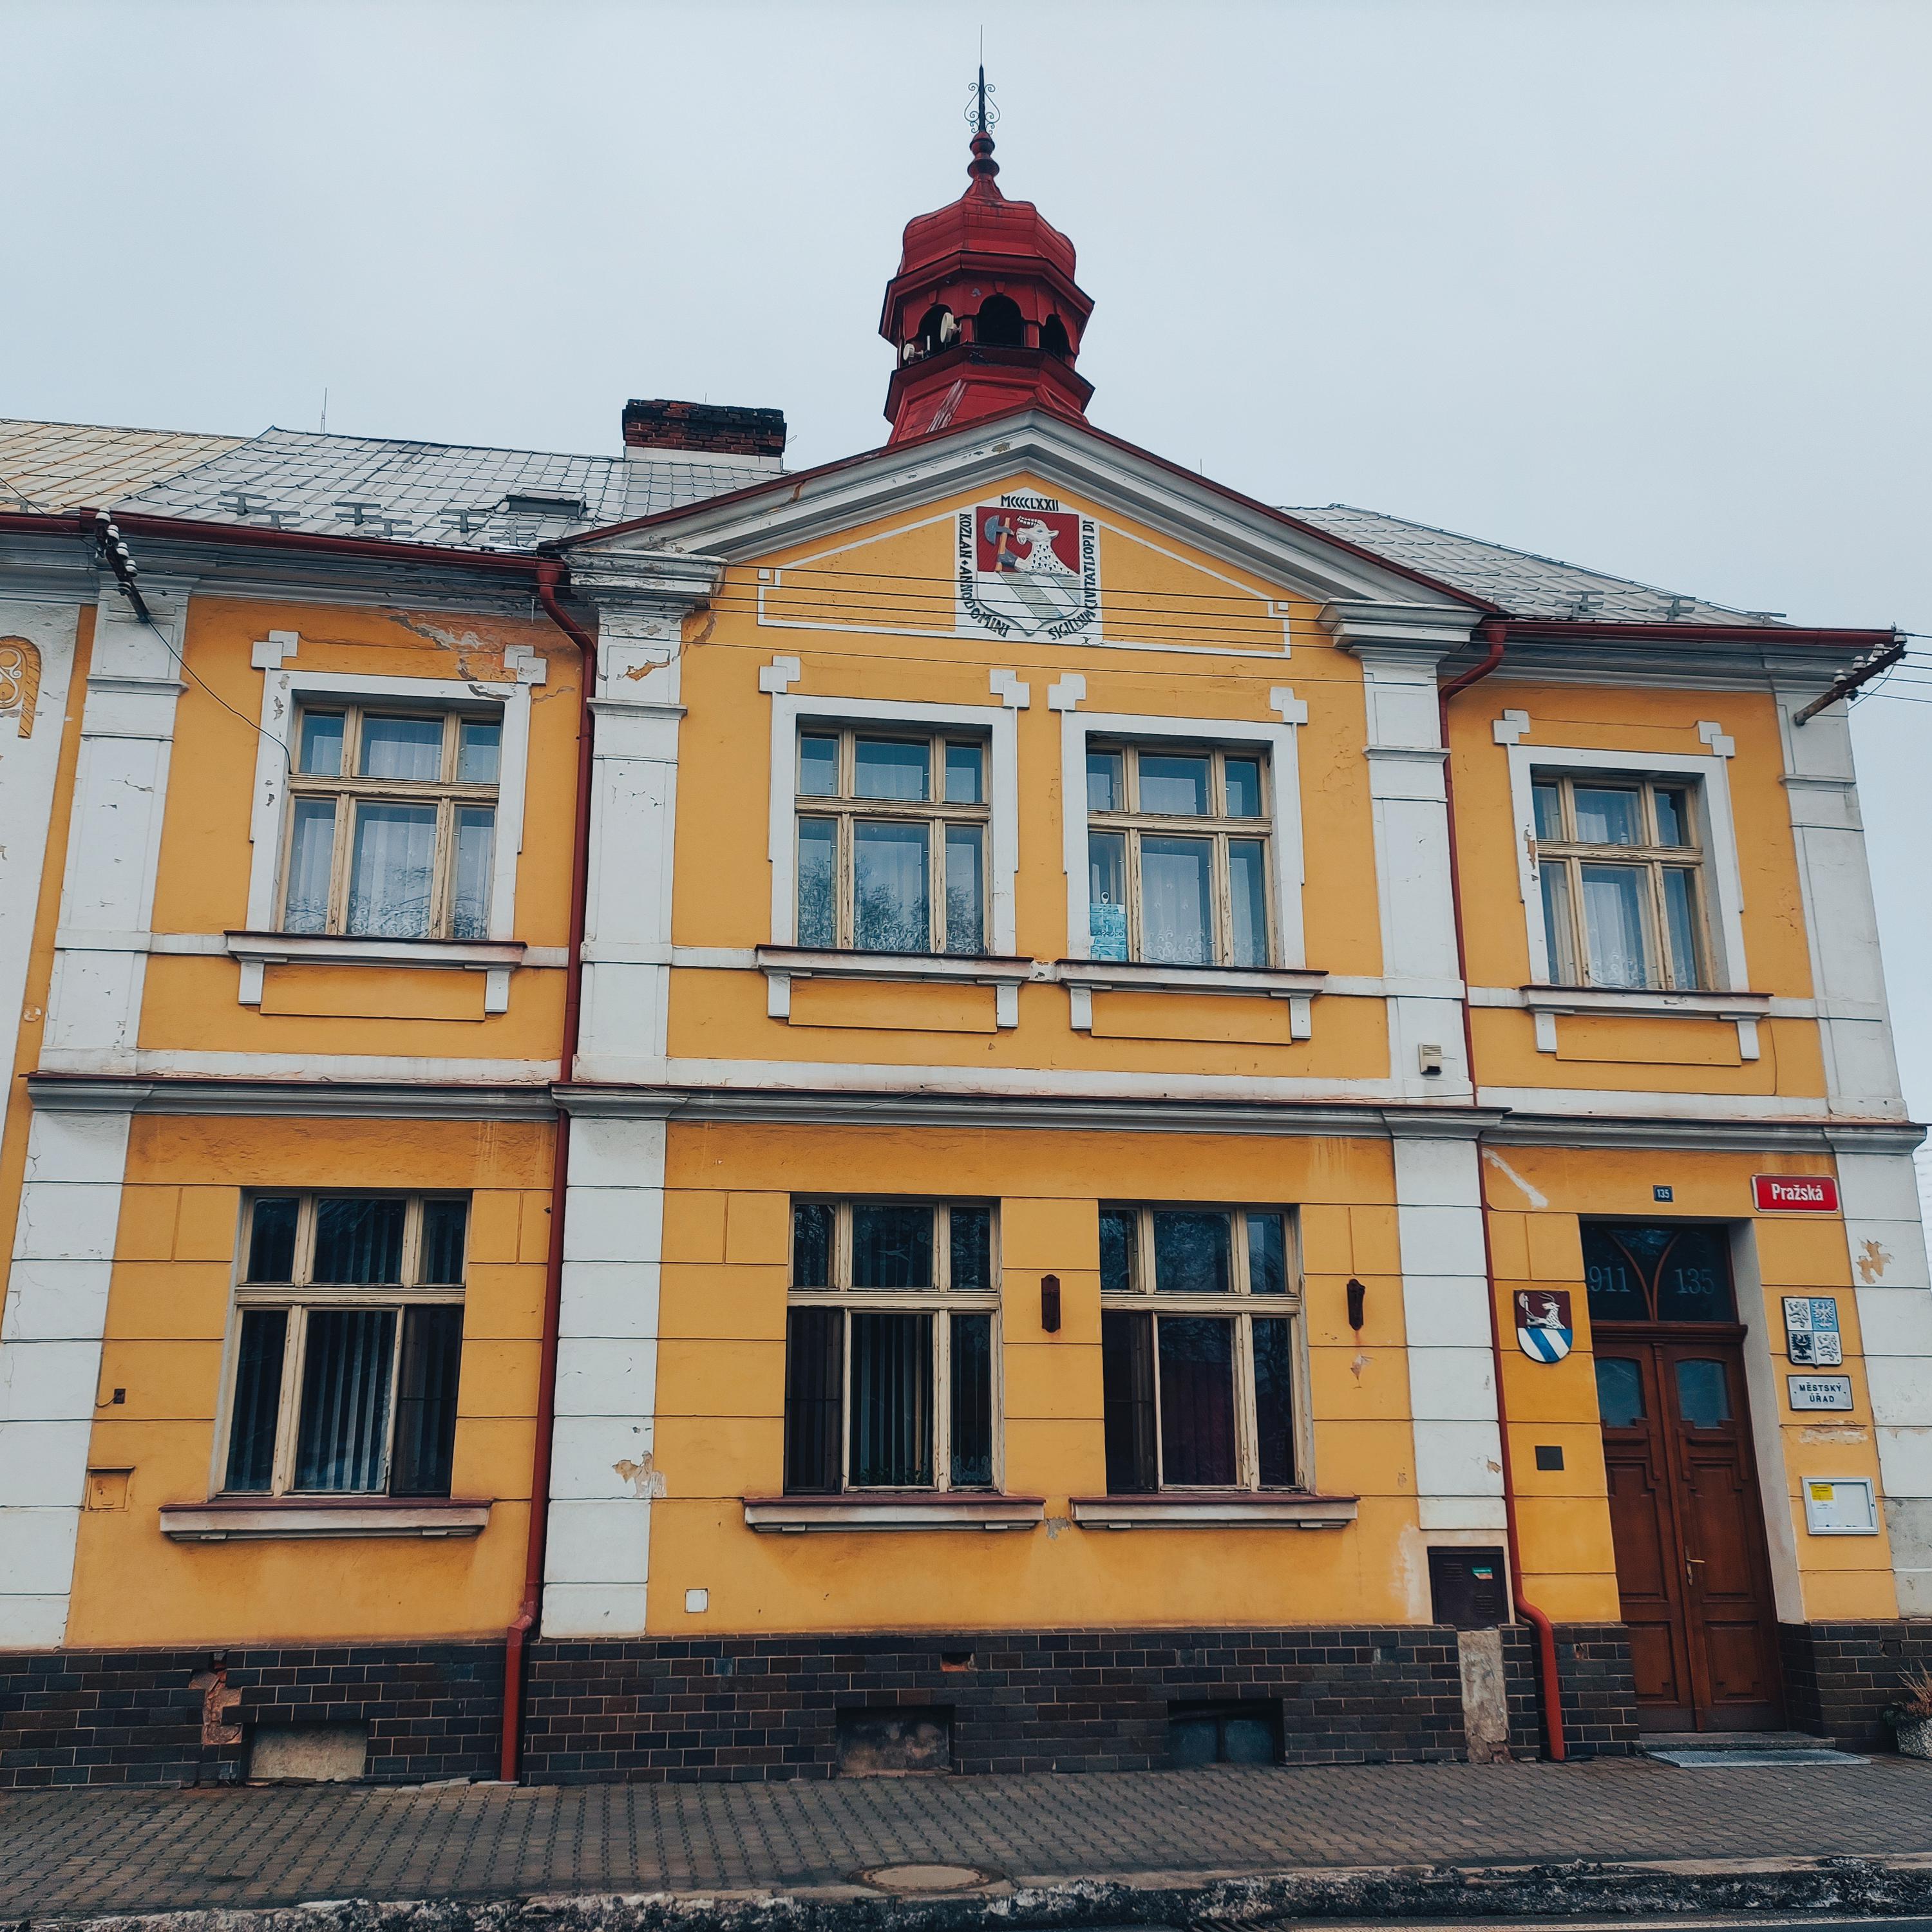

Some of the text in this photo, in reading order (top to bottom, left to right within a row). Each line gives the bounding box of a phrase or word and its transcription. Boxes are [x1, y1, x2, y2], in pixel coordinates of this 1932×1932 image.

[1001, 495, 1059, 511] MCCCCLXXII
[959, 513, 972, 559] KOZLAN
[1657, 1189, 1670, 1198] 135
[1771, 1183, 1824, 1201] Pražská
[1587, 1266, 1631, 1292] 911
[1676, 1268, 1714, 1294] 135
[1799, 1382, 1842, 1392] MĚSTSKÝ
[1809, 1393, 1835, 1402] ÚŘAD
